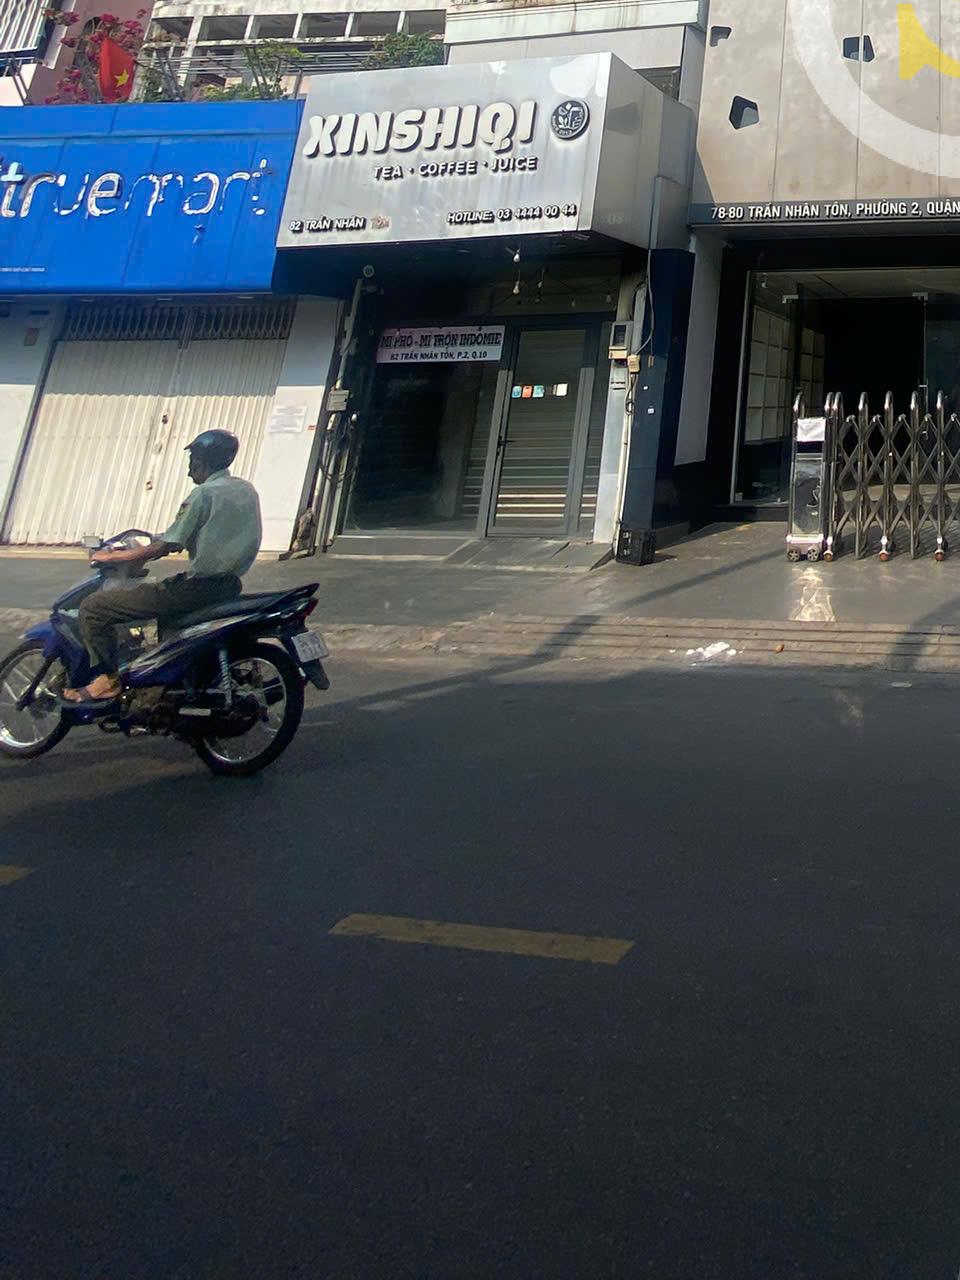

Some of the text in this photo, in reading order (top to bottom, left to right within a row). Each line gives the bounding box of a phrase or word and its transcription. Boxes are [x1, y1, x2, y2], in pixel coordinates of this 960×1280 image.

[303, 100, 537, 157] XINSHIQI
[375, 156, 538, 180] TEA COFFEE JUICE
[448, 204, 577, 225] HOTLINE: 03 4444 00 44
[711, 206, 744, 219] 78-80
[785, 202, 819, 218] NHÂN
[824, 201, 852, 218] TÔN,
[856, 199, 907, 215] PHƯỜNG
[911, 201, 922, 216] 2,
[927, 198, 960, 215] QUẬN
[289, 221, 304, 233] 82
